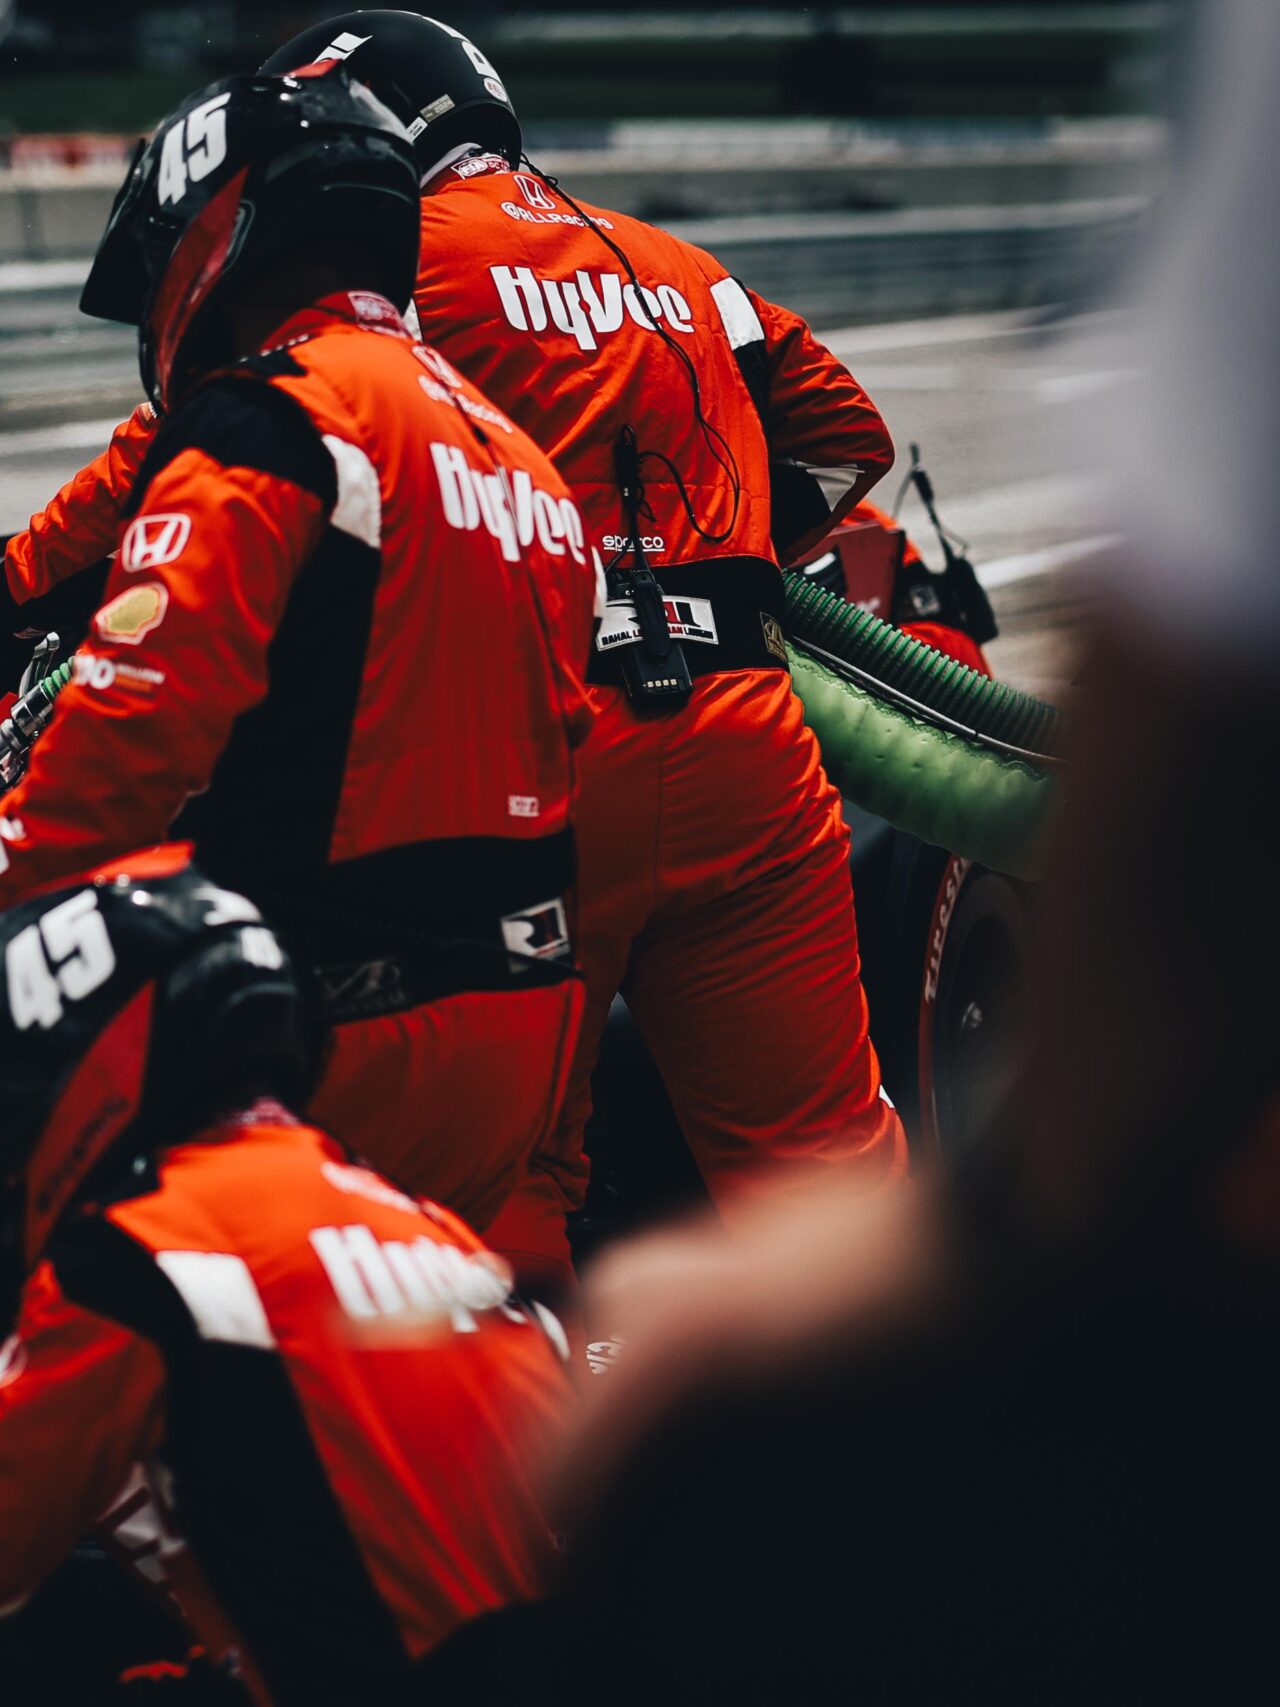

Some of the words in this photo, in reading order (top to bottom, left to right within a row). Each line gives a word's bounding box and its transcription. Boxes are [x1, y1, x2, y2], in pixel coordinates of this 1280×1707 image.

[158, 92, 231, 205] 45
[489, 265, 695, 350] HyVee
[5, 888, 116, 1031] 45
